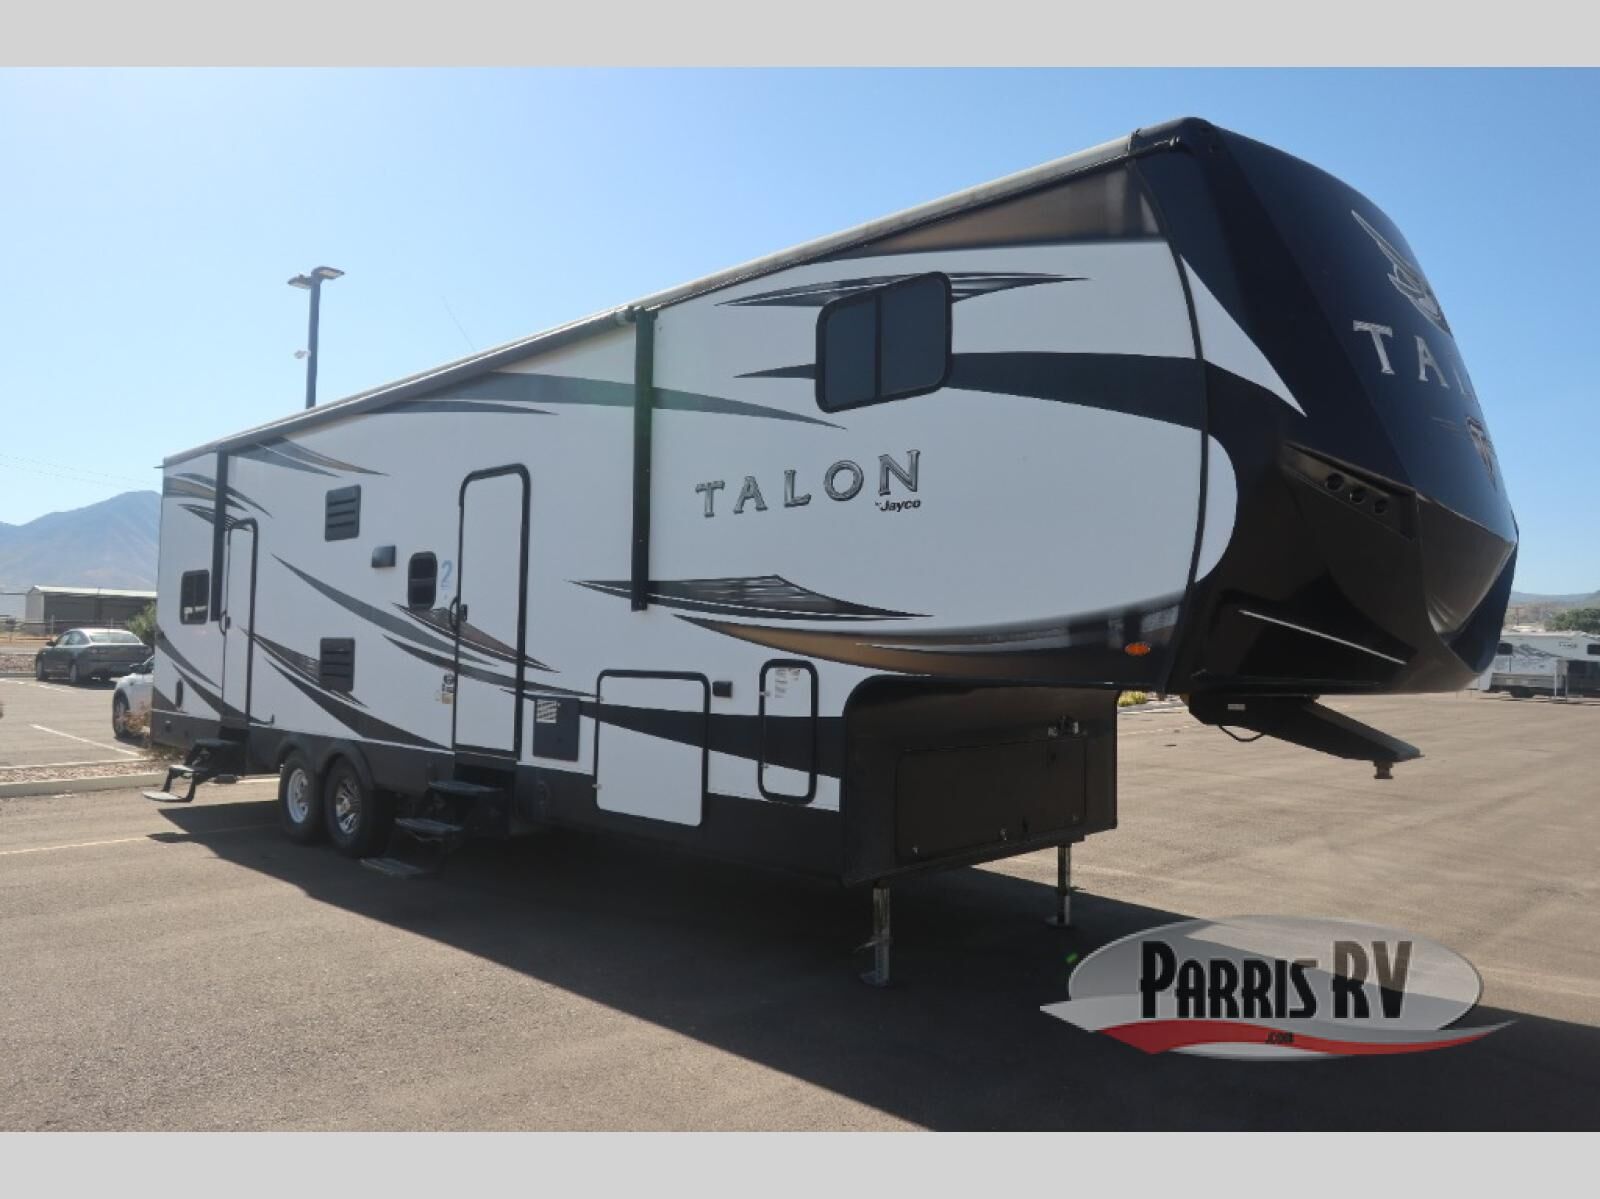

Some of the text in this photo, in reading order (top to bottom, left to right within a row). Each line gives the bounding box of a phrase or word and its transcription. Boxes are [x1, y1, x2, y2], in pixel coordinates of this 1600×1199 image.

[695, 450, 920, 518] TALON
[880, 500, 921, 512] Jayco
[441, 560, 453, 588] 2
